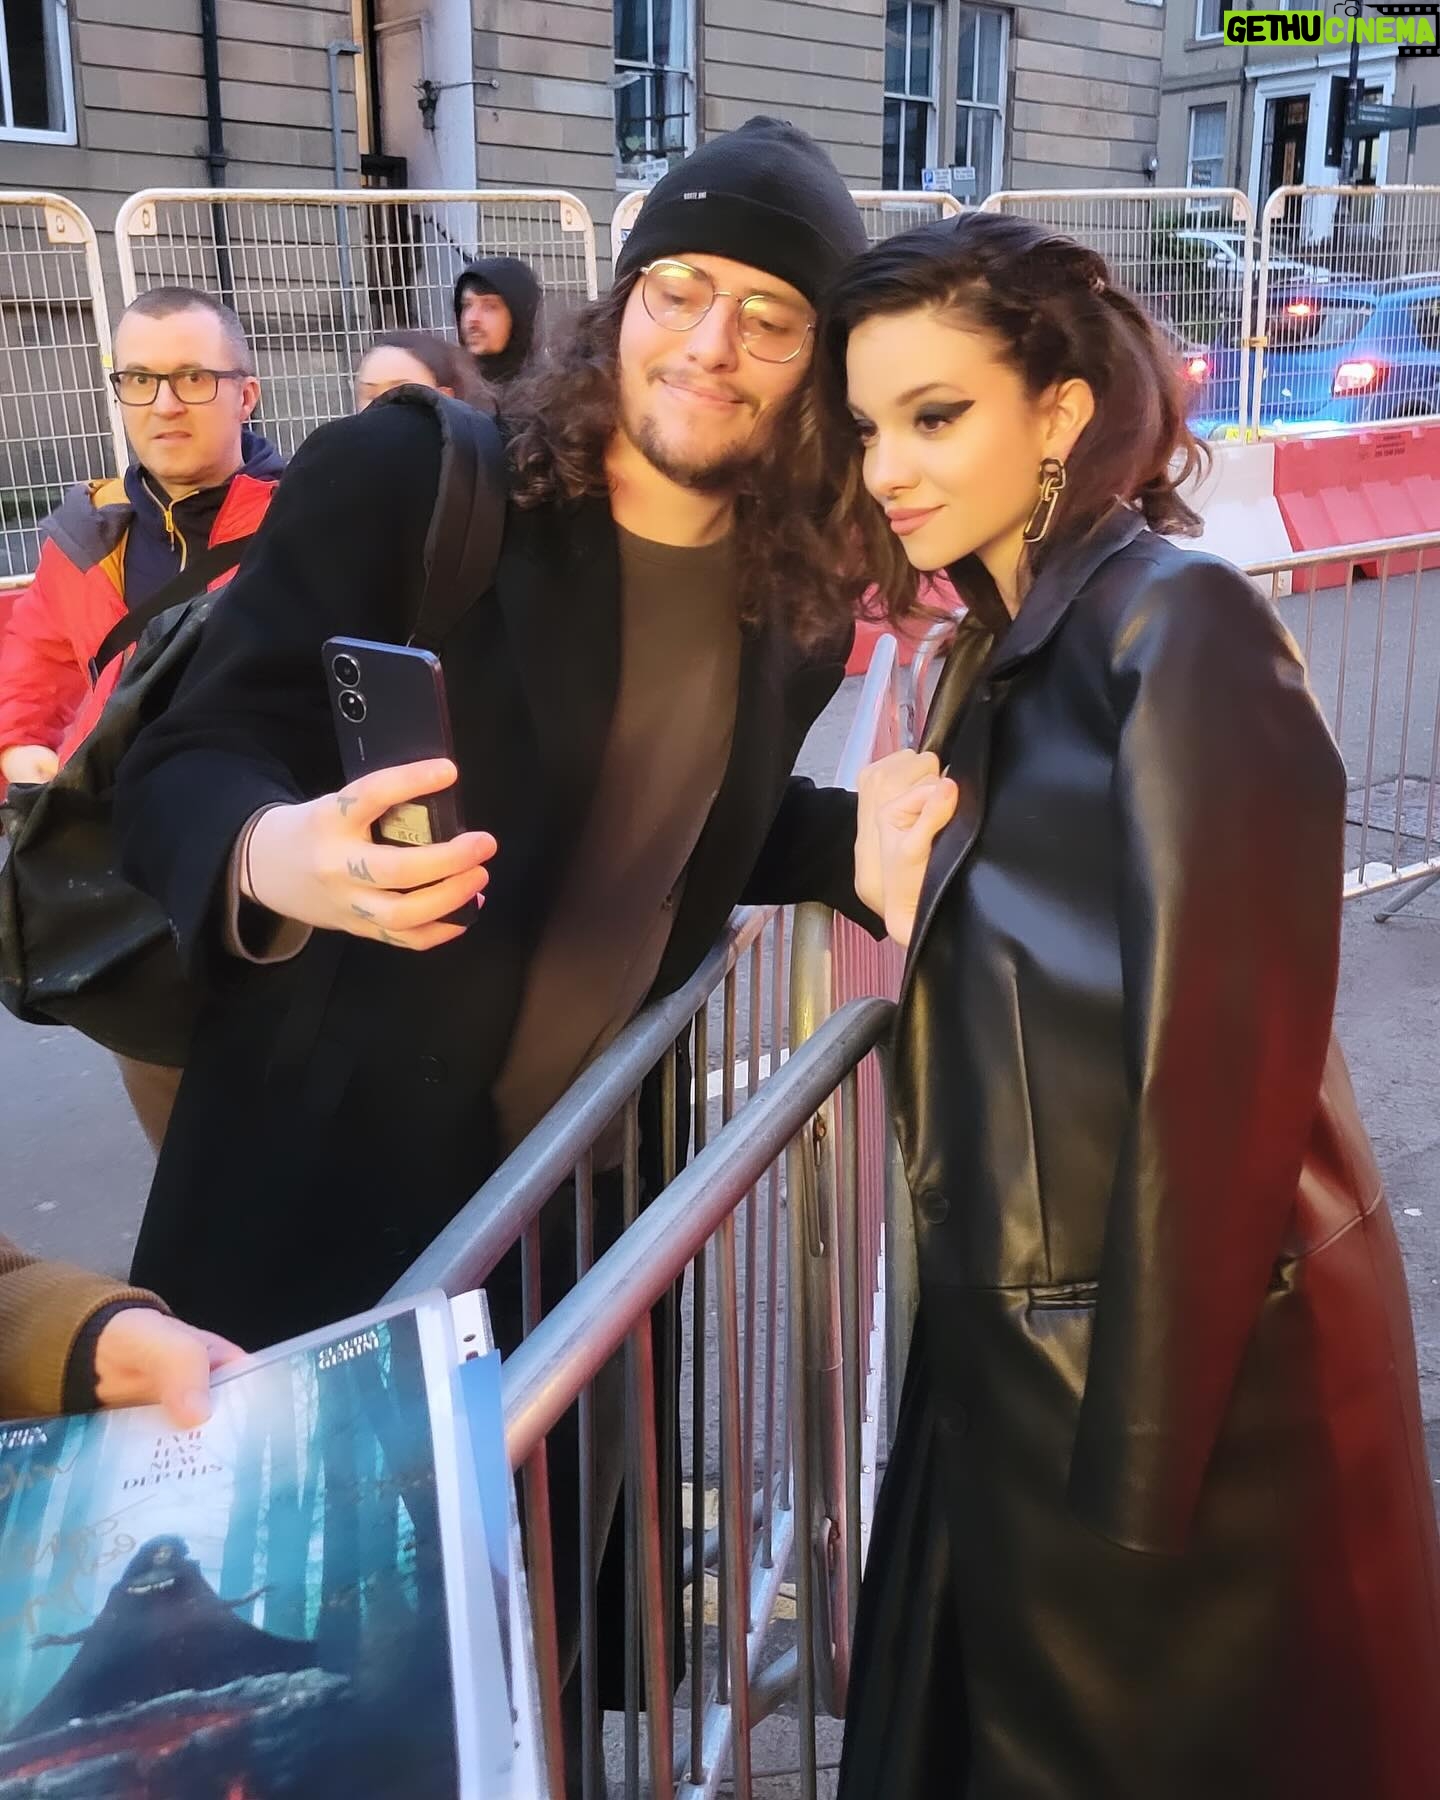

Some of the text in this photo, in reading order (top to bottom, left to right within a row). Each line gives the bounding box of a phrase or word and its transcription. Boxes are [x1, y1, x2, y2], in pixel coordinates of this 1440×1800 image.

[319, 1330, 378, 1359] CLAUDIA
[153, 1443, 202, 1460] HAS
[122, 1464, 222, 1490] DEPTHS
